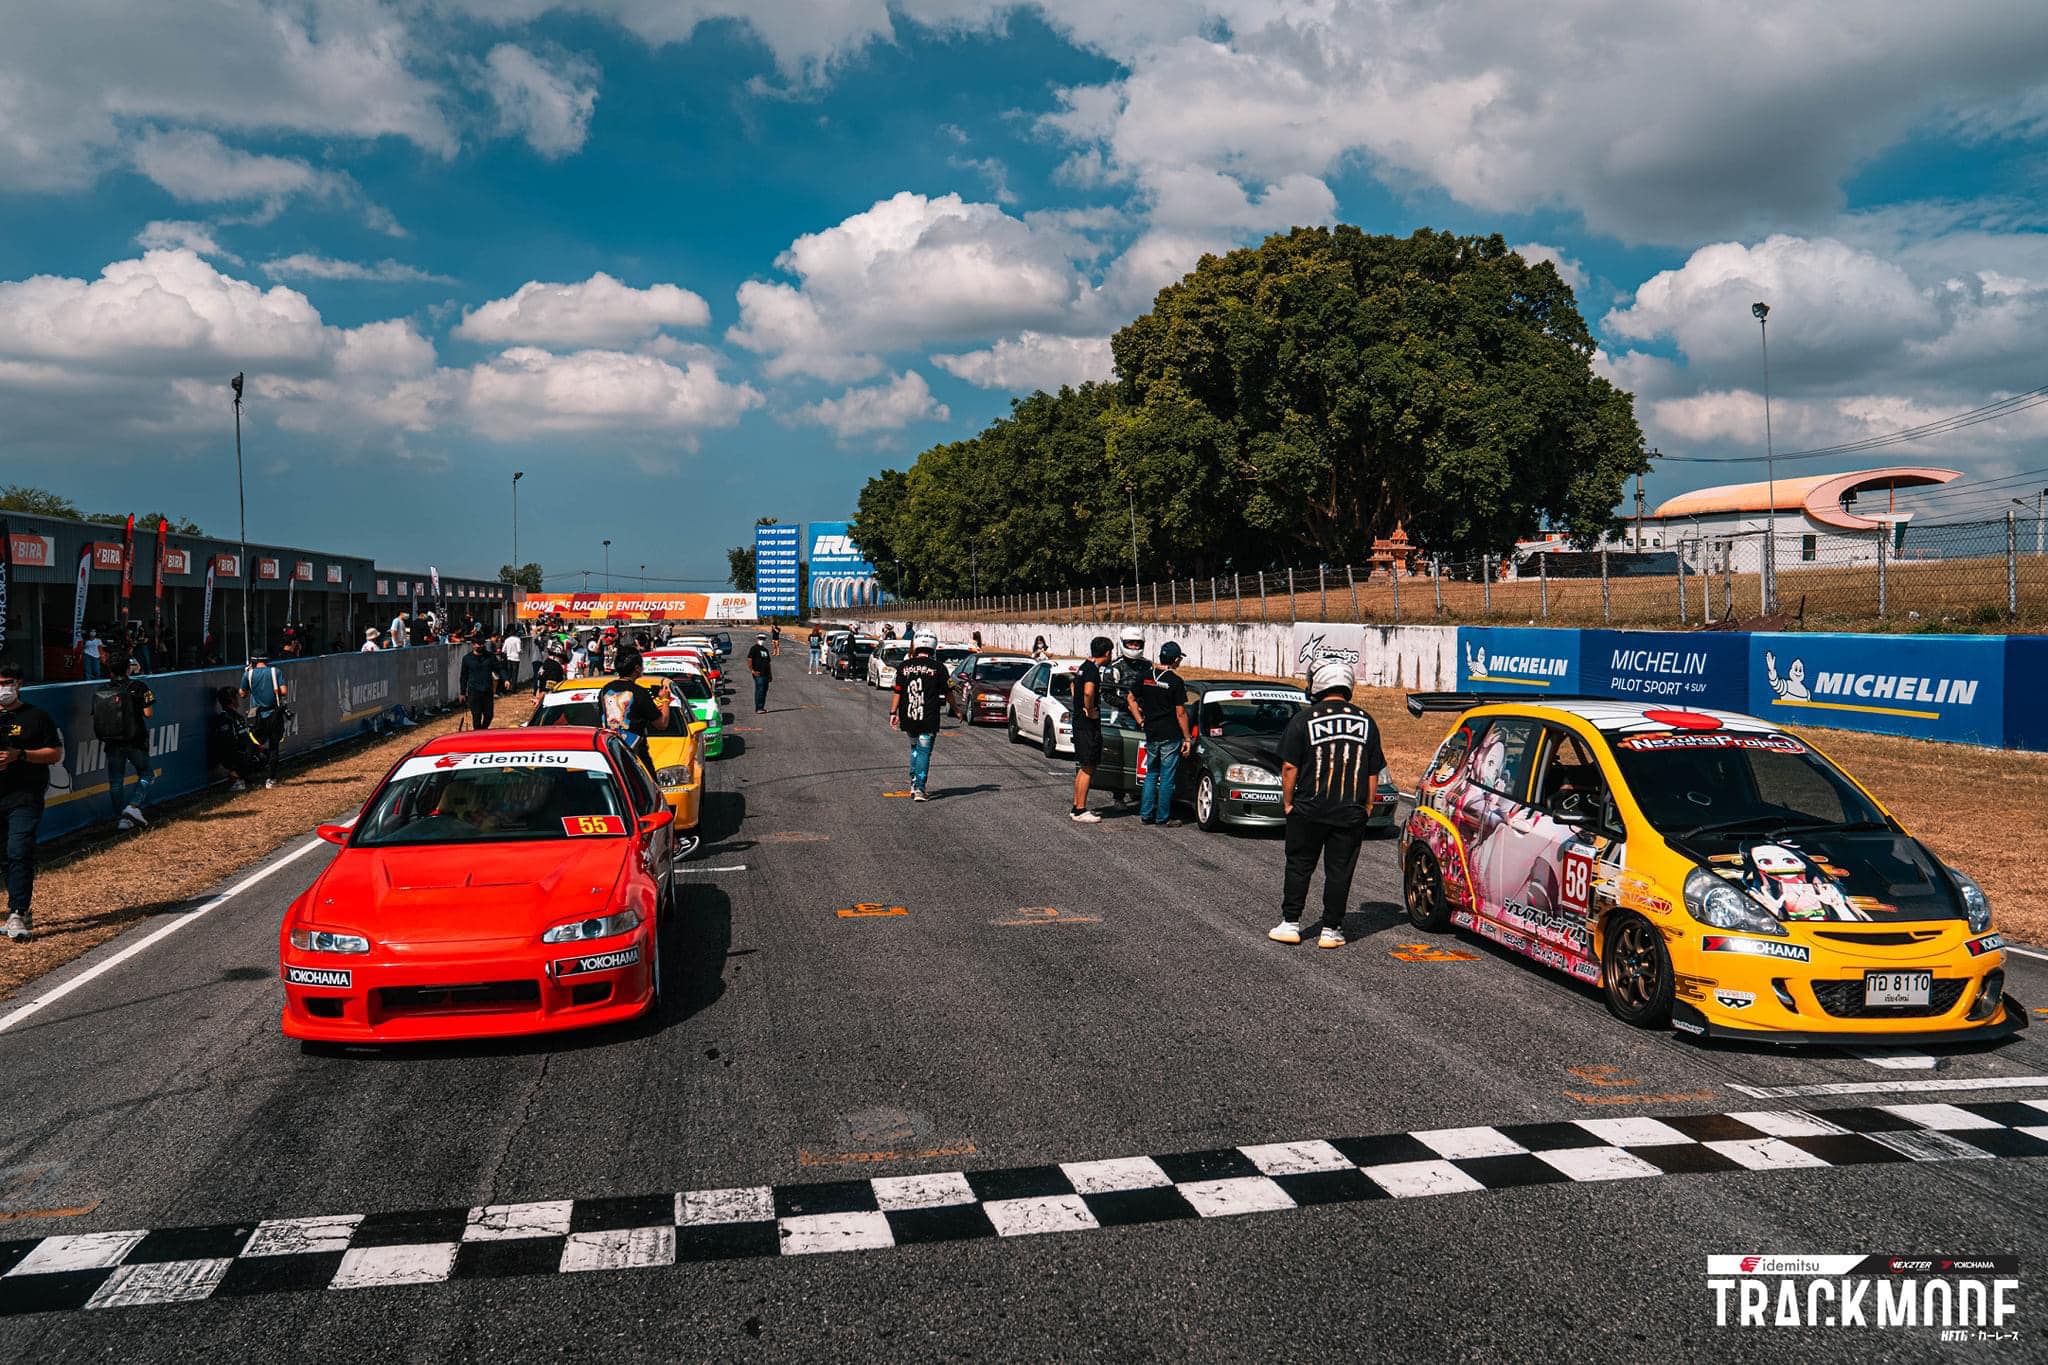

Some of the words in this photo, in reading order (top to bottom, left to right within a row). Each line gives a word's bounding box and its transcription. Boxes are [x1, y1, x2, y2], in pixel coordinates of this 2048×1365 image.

[17, 543, 42, 560] BIRA
[101, 549, 121, 565] BIRA
[168, 555, 183, 568] BIRA
[220, 559, 234, 572] BIRA
[573, 601, 613, 611] RACING
[616, 600, 686, 611] ENTHUSIASTS
[722, 597, 747, 607] BIRA
[1488, 655, 1568, 677] MICHELIN
[1610, 649, 1707, 674] MICHELIN
[352, 679, 389, 705] MICHELIN
[1610, 677, 1640, 693] PILOT
[1642, 679, 1682, 695] SPORT
[1690, 683, 1707, 693] SUV
[1814, 670, 1979, 705] MICHELIN
[1250, 691, 1302, 701] idemitsu
[472, 751, 570, 767] idemitsu
[1240, 791, 1280, 802] YOKOHAMA
[578, 816, 609, 834] 55
[1565, 858, 1588, 902] 58
[1730, 938, 1808, 961] YOKOHAMA
[580, 947, 640, 972] YOKOHAMA
[289, 969, 349, 986] YOKOHAMA
[1867, 975, 1888, 992] กอ
[1893, 975, 1930, 992] 8110
